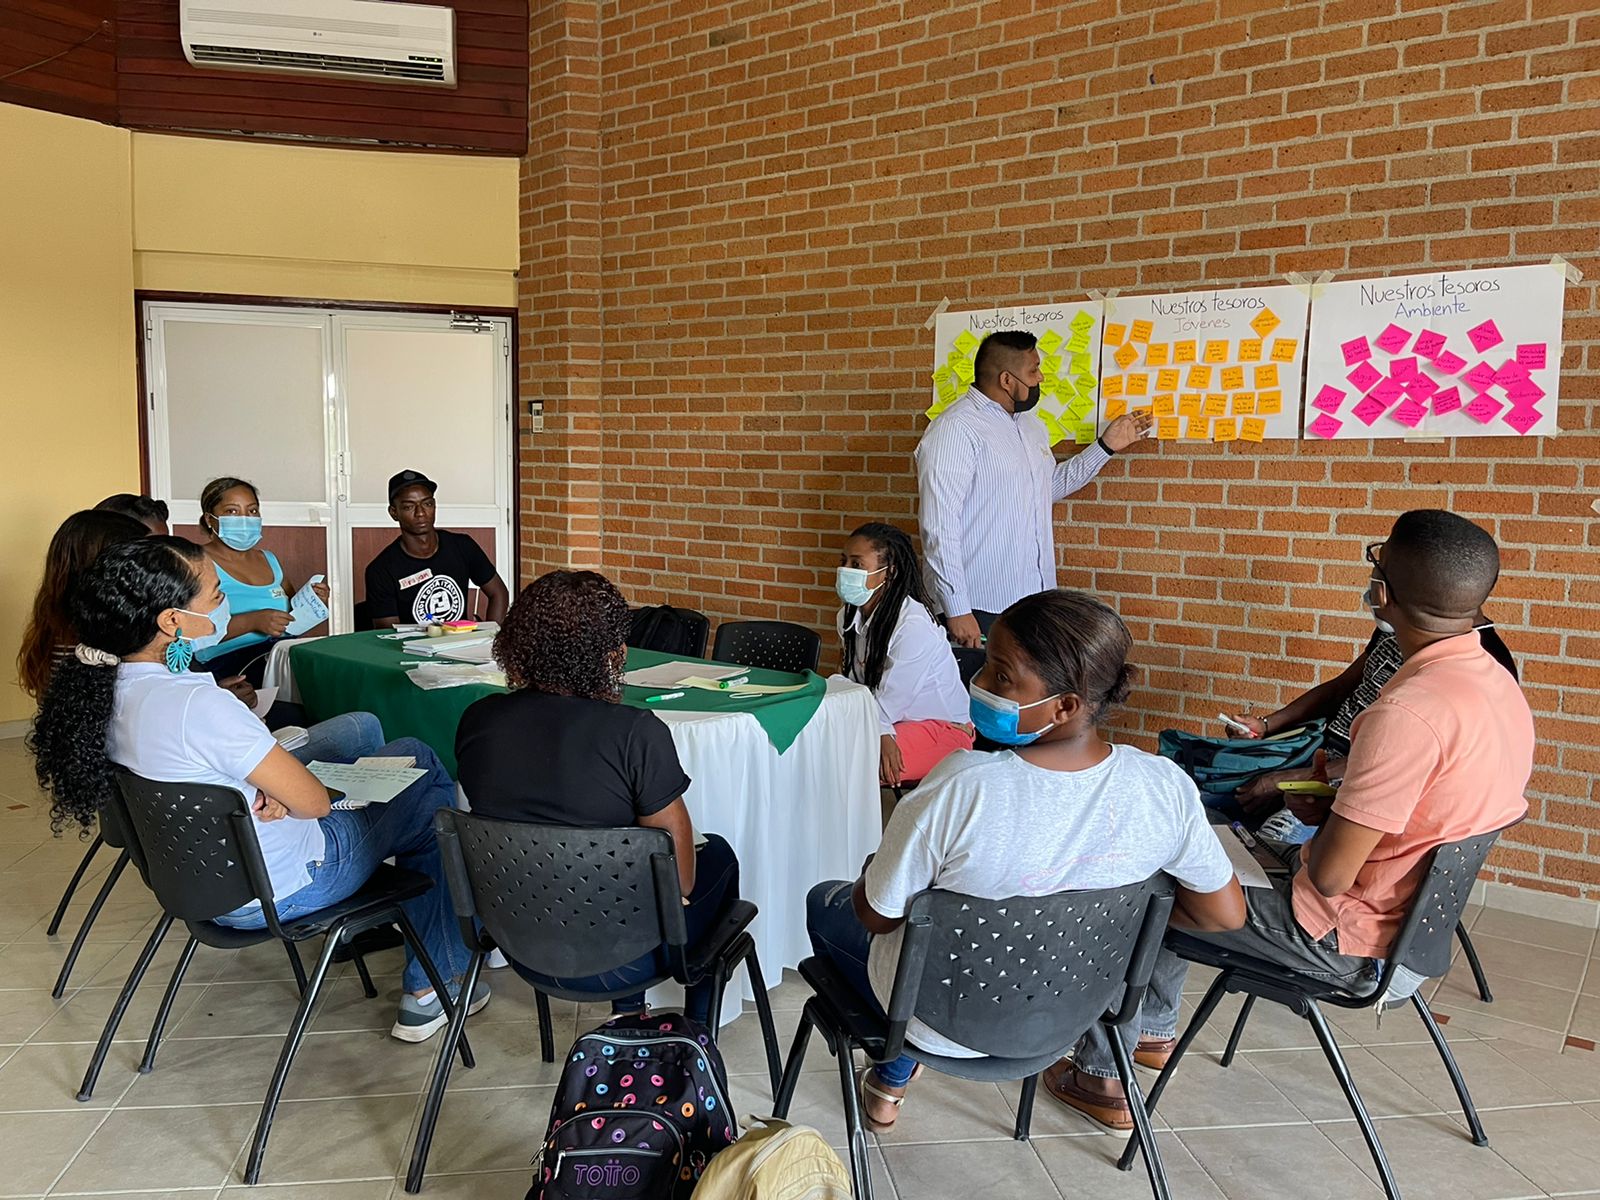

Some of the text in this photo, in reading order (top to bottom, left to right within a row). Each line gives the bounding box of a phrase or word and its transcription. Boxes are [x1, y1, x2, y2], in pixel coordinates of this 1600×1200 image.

[1360, 274, 1500, 306] Nuestros tesoros
[1151, 291, 1266, 316] Nuestros tesoros
[1394, 295, 1471, 319] Ambiente
[969, 307, 1064, 331] Nuestros tesoros
